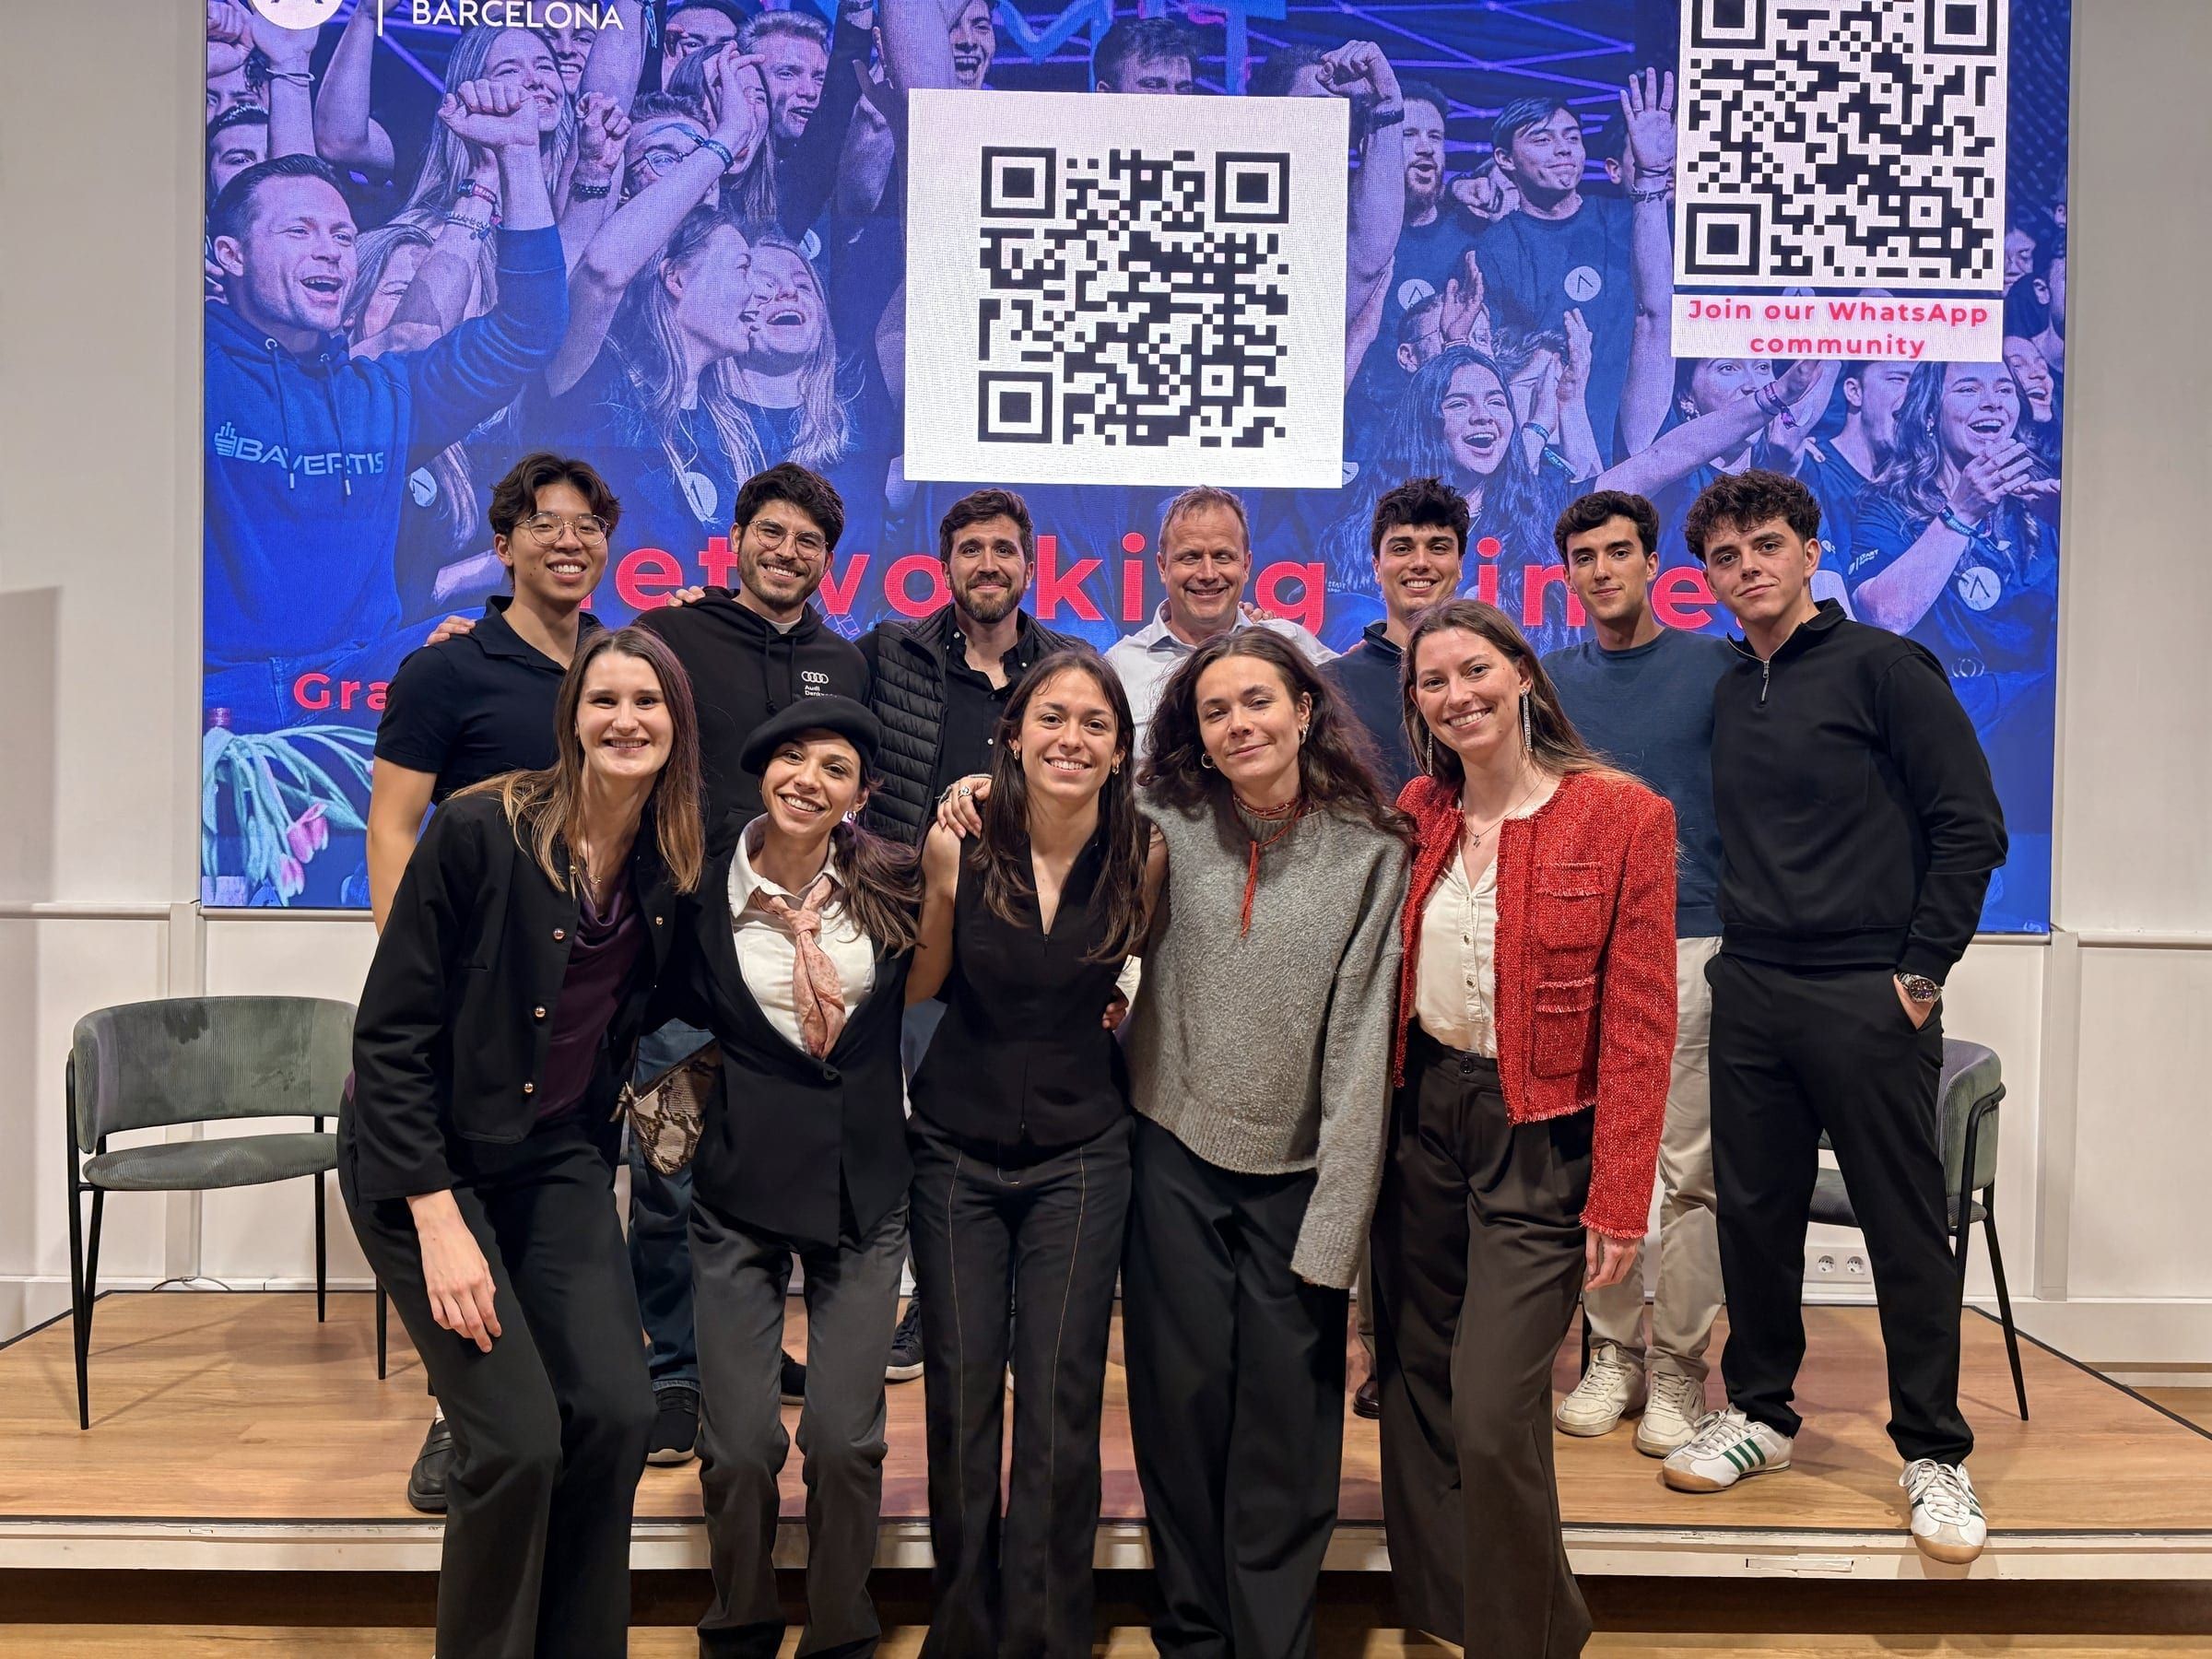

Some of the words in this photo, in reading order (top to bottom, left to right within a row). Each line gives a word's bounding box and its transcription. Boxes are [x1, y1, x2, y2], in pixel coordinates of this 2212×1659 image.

[411, 0, 625, 31] BARCELONA
[1688, 298, 1751, 320] Join
[1764, 301, 1815, 321] our
[1828, 301, 1988, 327] WhatsApp
[1749, 334, 1926, 359] community
